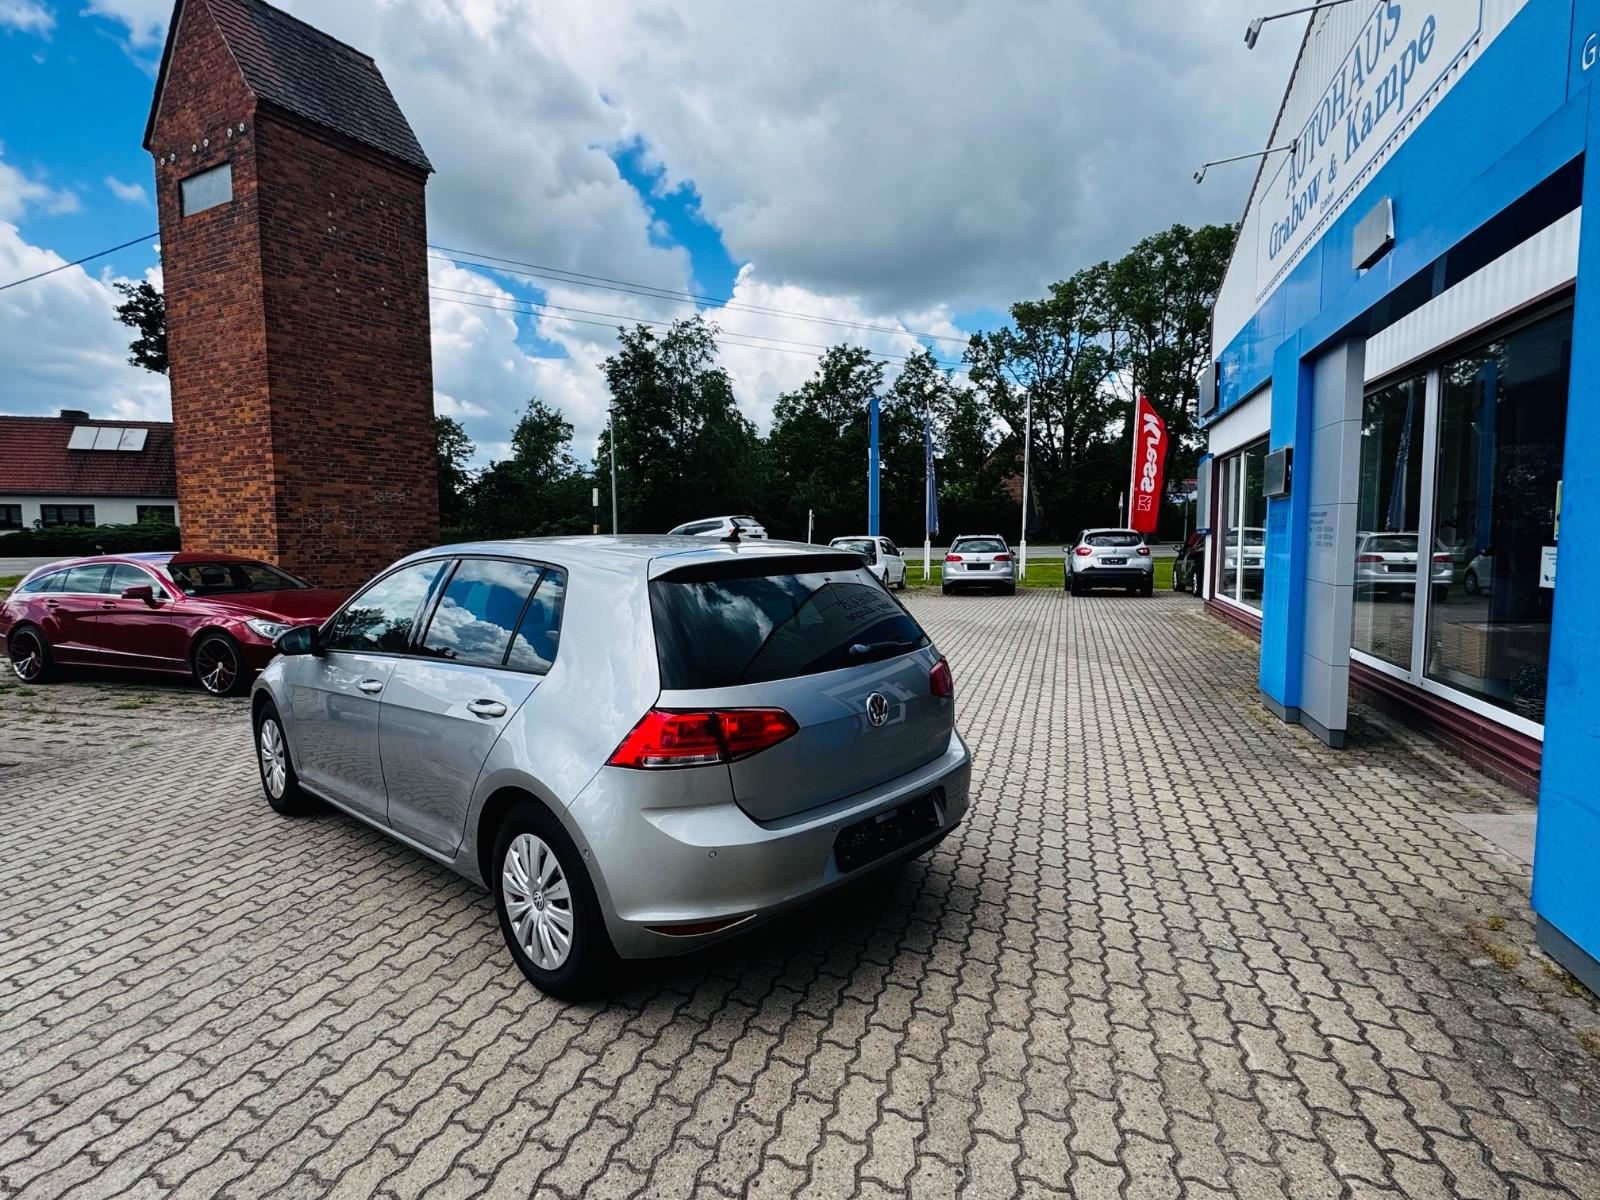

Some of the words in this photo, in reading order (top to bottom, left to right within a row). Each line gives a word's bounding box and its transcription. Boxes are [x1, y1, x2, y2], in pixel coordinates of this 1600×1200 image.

[1268, 166, 1324, 262] Grabow
[1327, 153, 1338, 185] &
[1344, 13, 1437, 165] Kampe
[1285, 0, 1401, 201] AUTOHAUS
[1582, 31, 1600, 71] G
